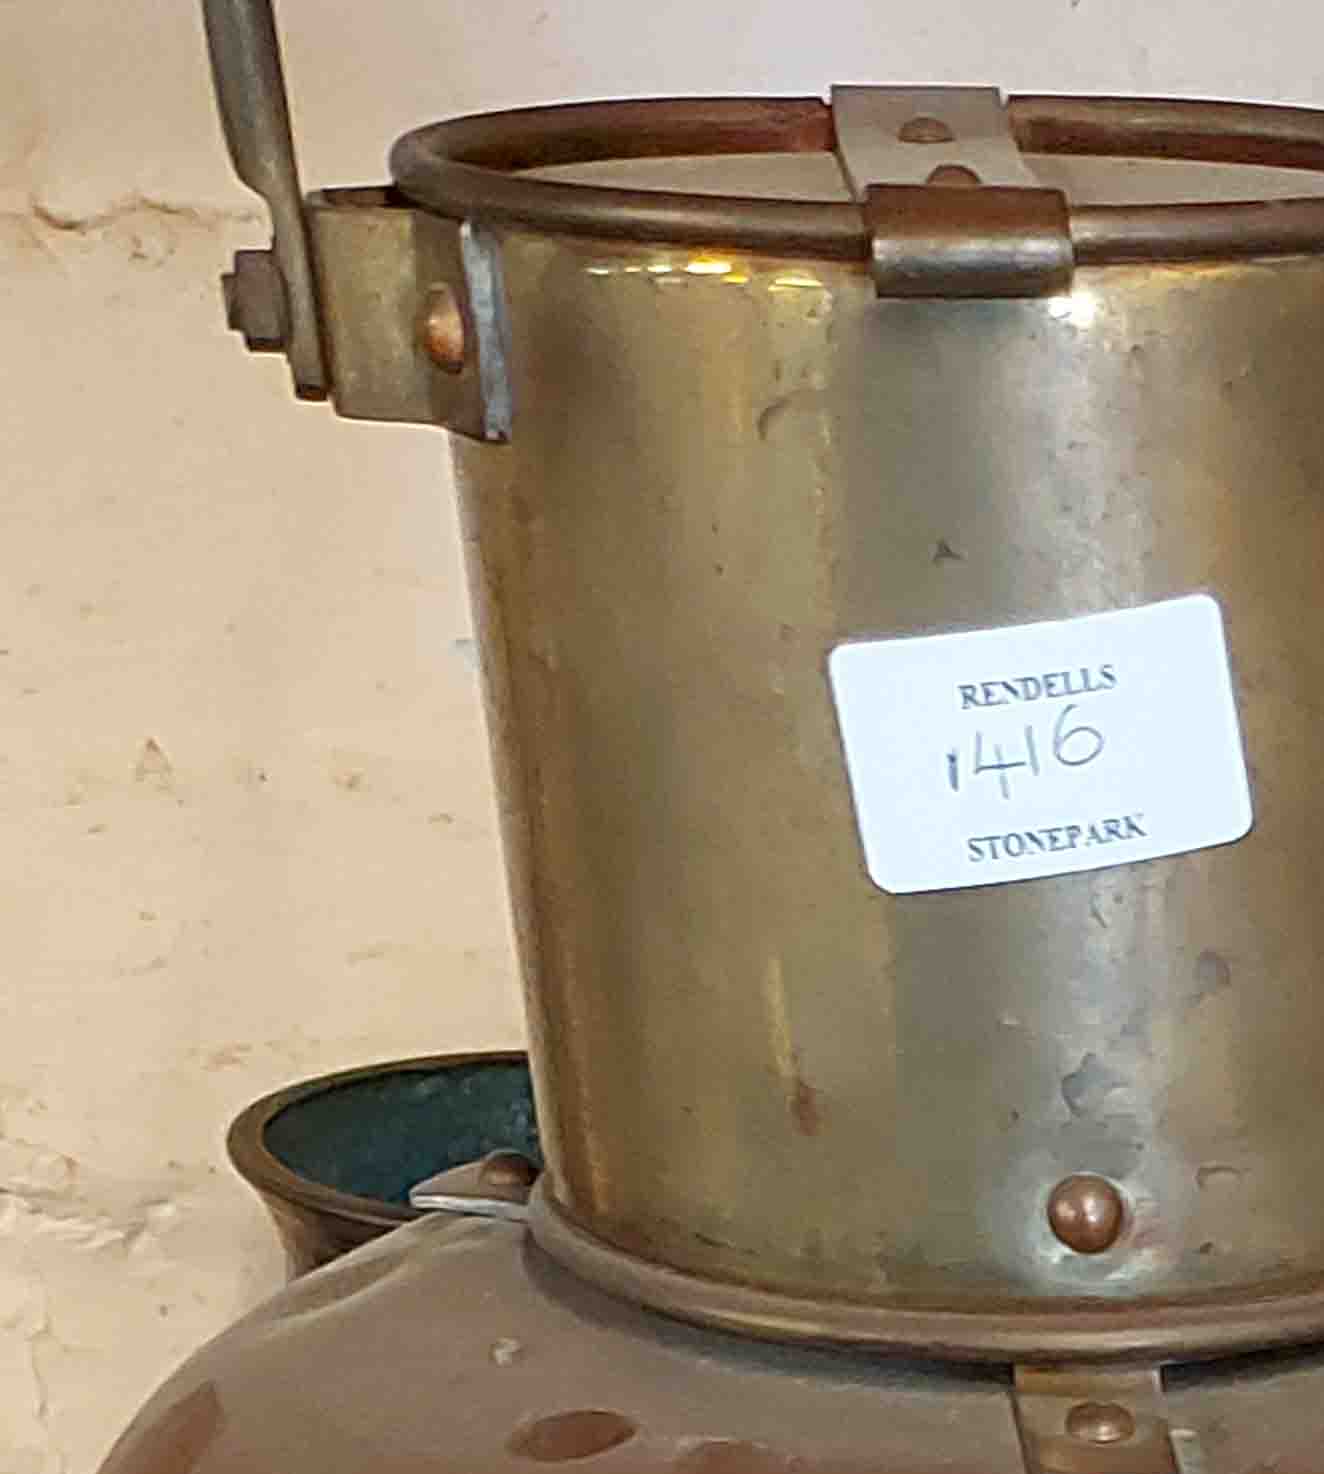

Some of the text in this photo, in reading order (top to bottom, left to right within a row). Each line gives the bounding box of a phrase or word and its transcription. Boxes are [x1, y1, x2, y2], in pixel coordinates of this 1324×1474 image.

[959, 664, 1117, 709] RENDELLS
[946, 703, 1104, 800] 1416
[966, 813, 1147, 863] STONEPARK
